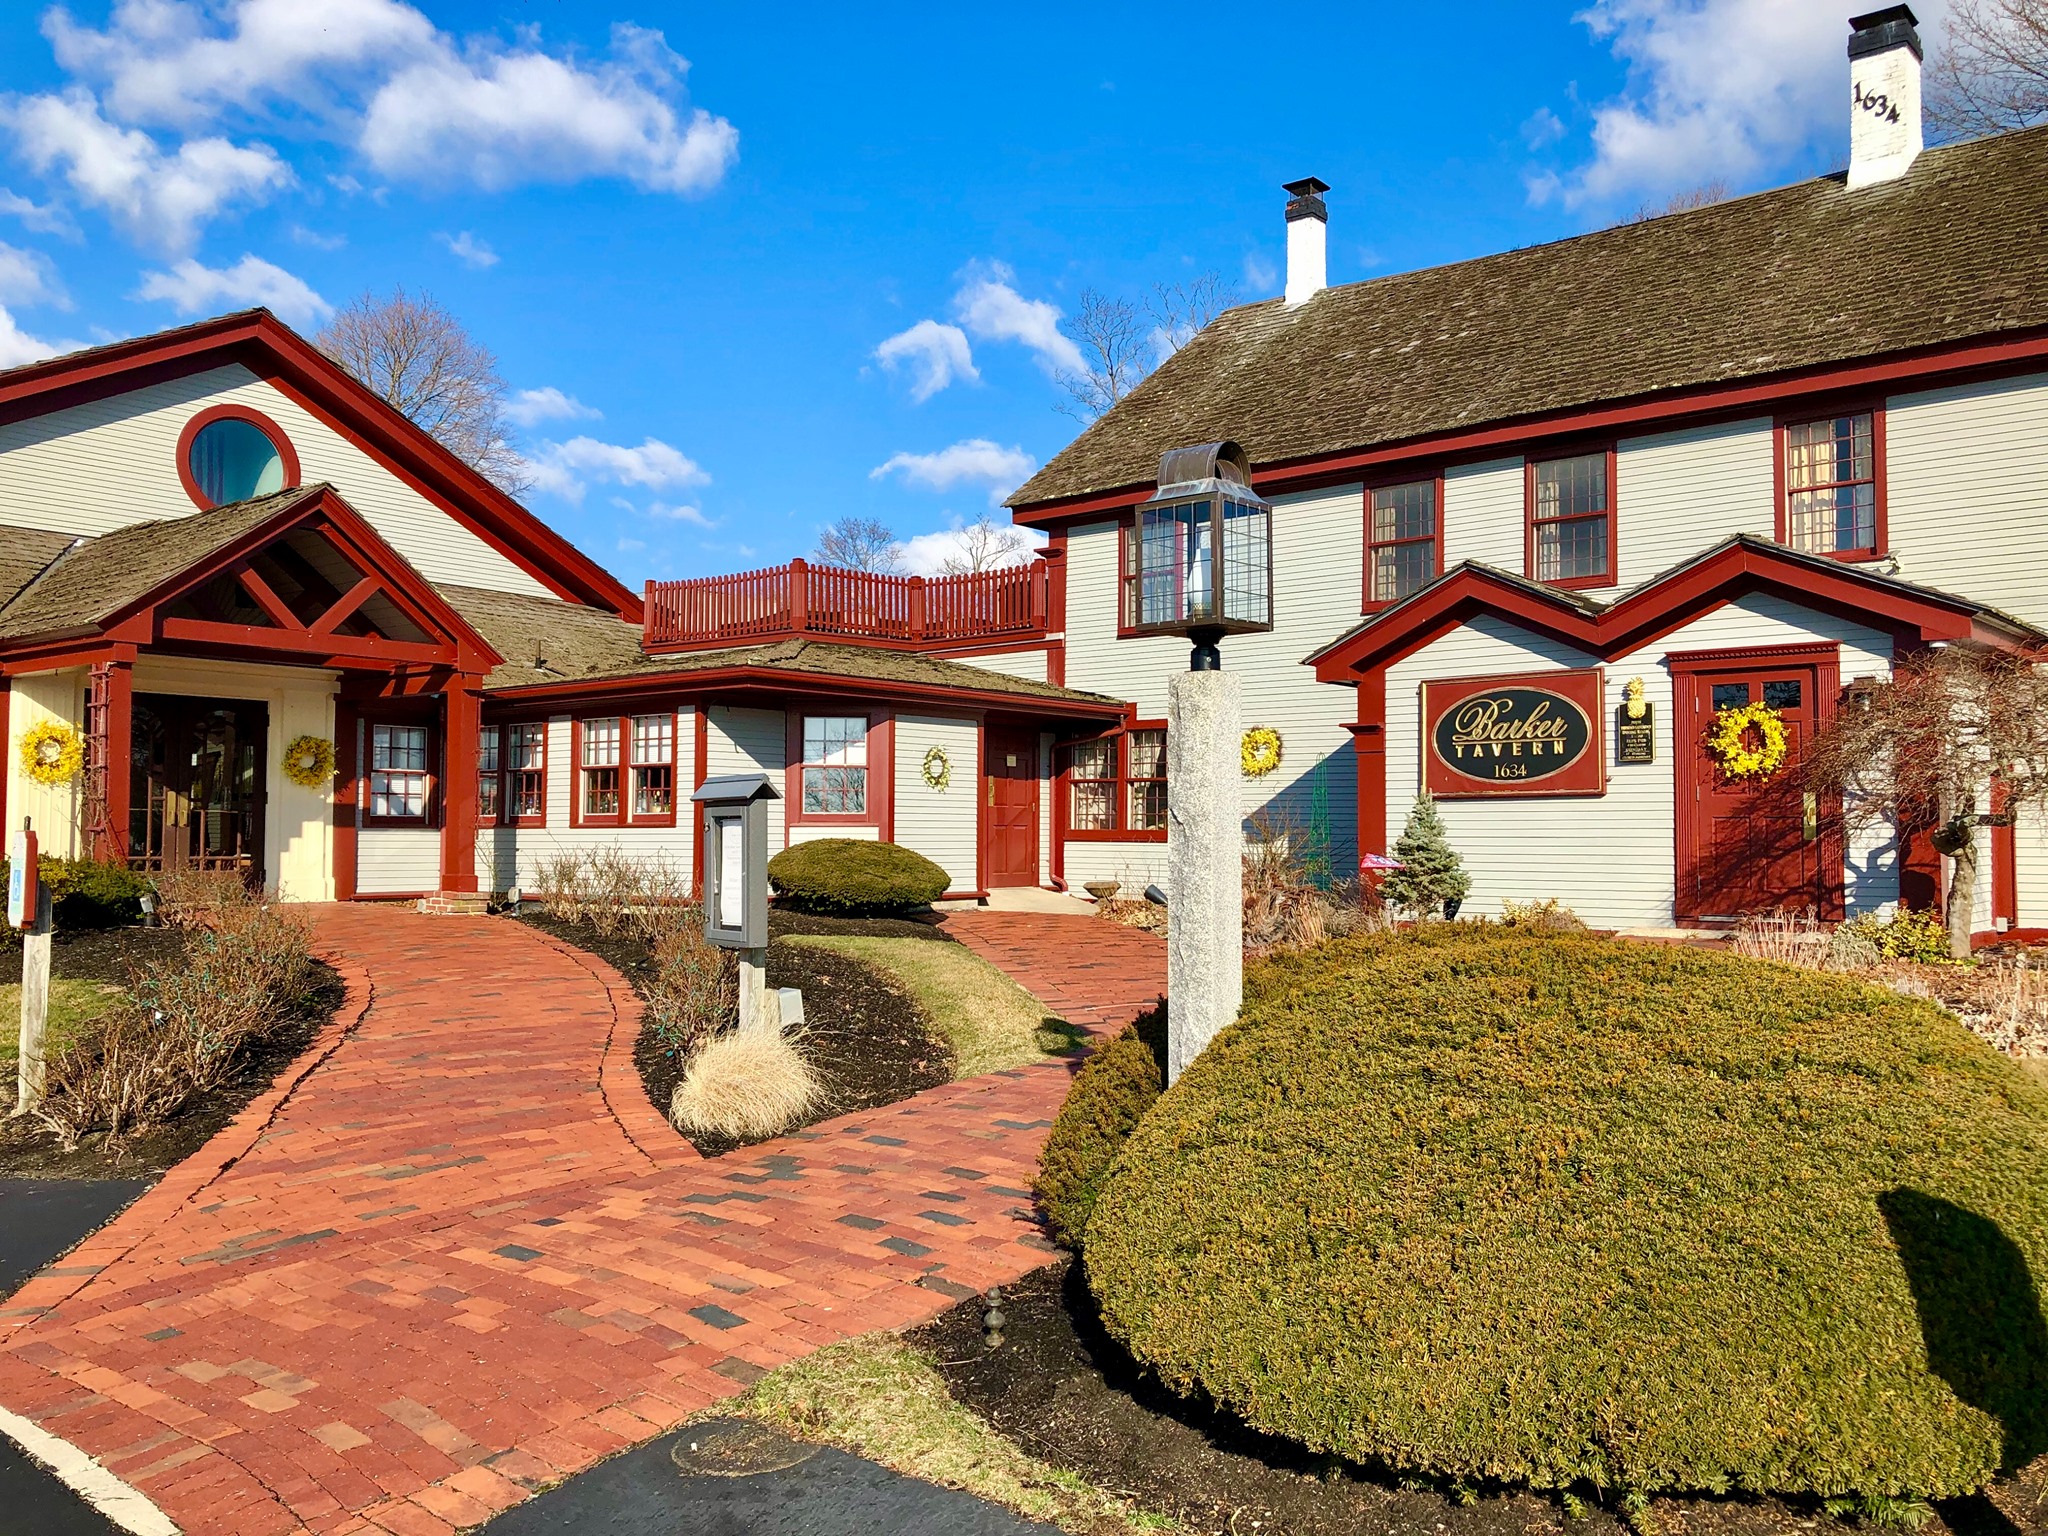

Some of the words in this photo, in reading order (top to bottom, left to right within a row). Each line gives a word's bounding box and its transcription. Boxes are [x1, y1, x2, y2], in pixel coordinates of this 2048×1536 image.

[1853, 80, 1900, 125] 1634
[1452, 698, 1569, 740] Barker
[1455, 740, 1564, 758] TAVERN
[1494, 762, 1528, 778] 1634
